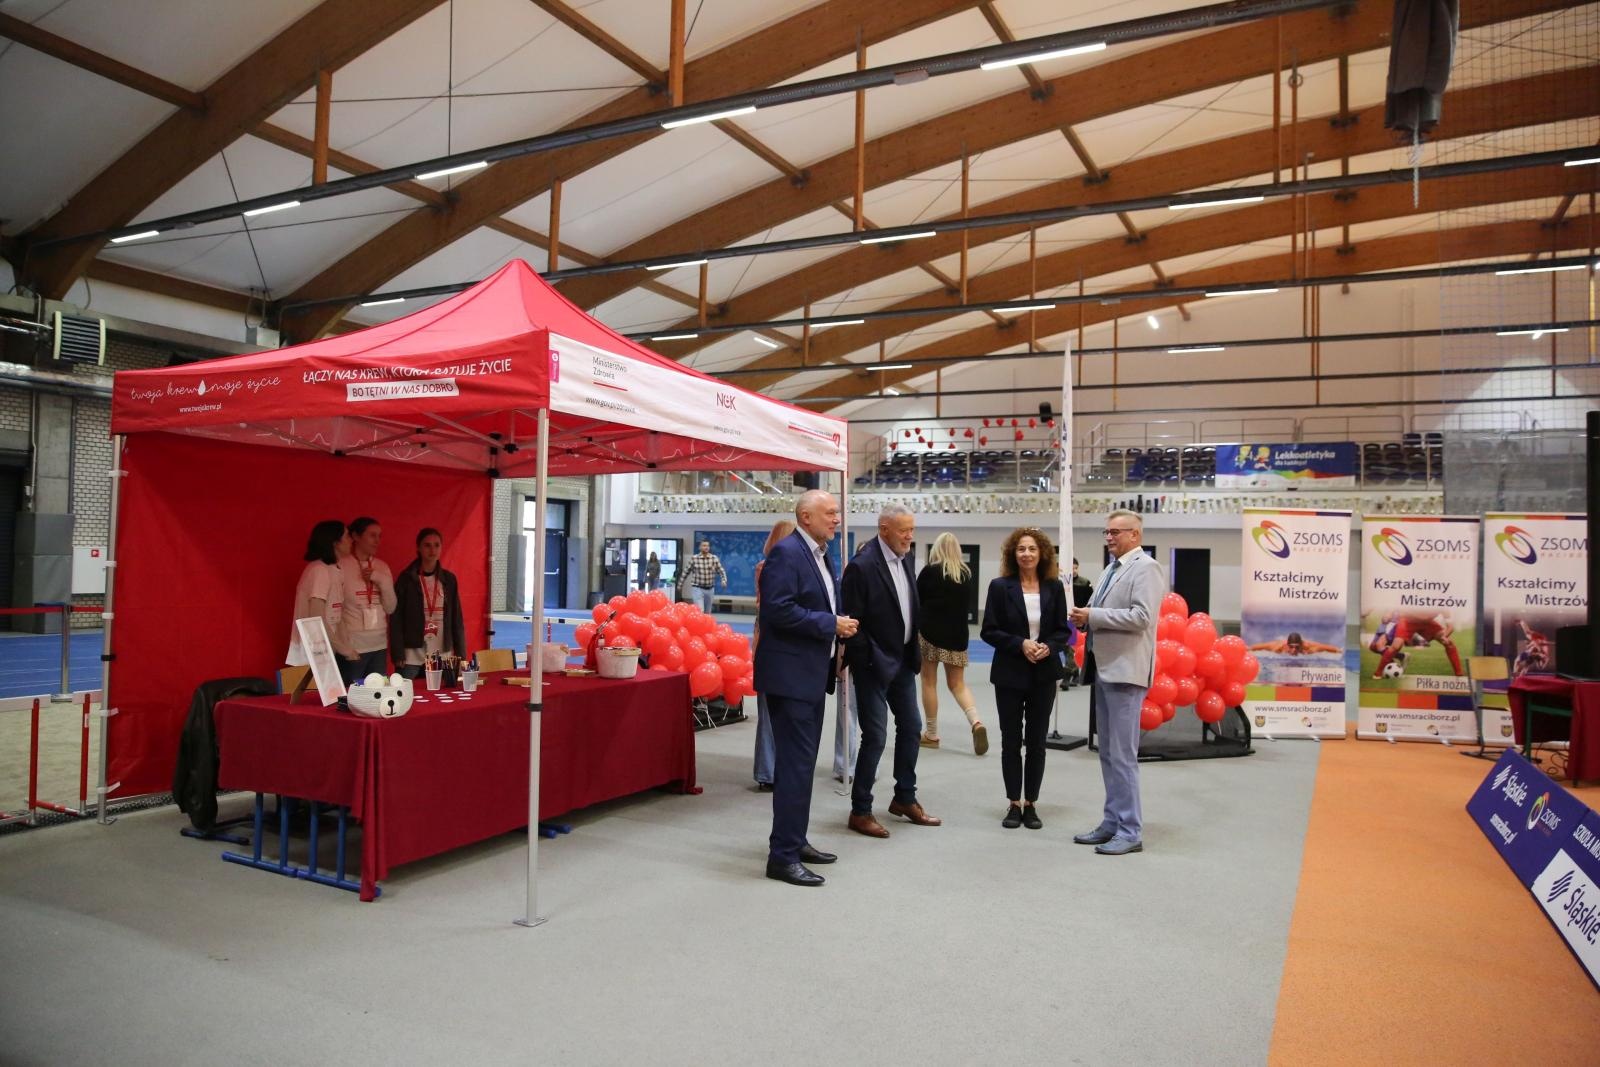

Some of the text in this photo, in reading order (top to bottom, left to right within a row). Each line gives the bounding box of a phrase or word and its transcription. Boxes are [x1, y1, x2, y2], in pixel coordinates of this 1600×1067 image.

[303, 369, 334, 384] ŁĄCZY
[334, 369, 358, 380] NAS
[479, 358, 512, 375] ŻYCIE
[592, 356, 627, 373] Ministerstwo
[593, 367, 615, 379] Zdrowia
[131, 376, 281, 404] twoja krew moje życie
[352, 383, 454, 397] BO TĘTNI W NAS DOBRO
[1275, 450, 1336, 461] Lekkoatletyka
[1293, 532, 1343, 546] ZSOMS
[1416, 539, 1471, 552] ZSOMS
[1540, 537, 1588, 551] ZSOM
[1254, 570, 1324, 586] Kształcimy
[1374, 578, 1450, 593] Kształcimy
[1497, 577, 1576, 593] Kształcimy
[1279, 587, 1339, 600] Mistrzów
[1401, 594, 1467, 607] Mistrzów
[1301, 670, 1342, 683] Pływanie
[1416, 678, 1440, 689] Piłka
[1255, 705, 1332, 713] www.smsraciborz.pl
[1376, 713, 1460, 722] www.smsraciborz.pl
